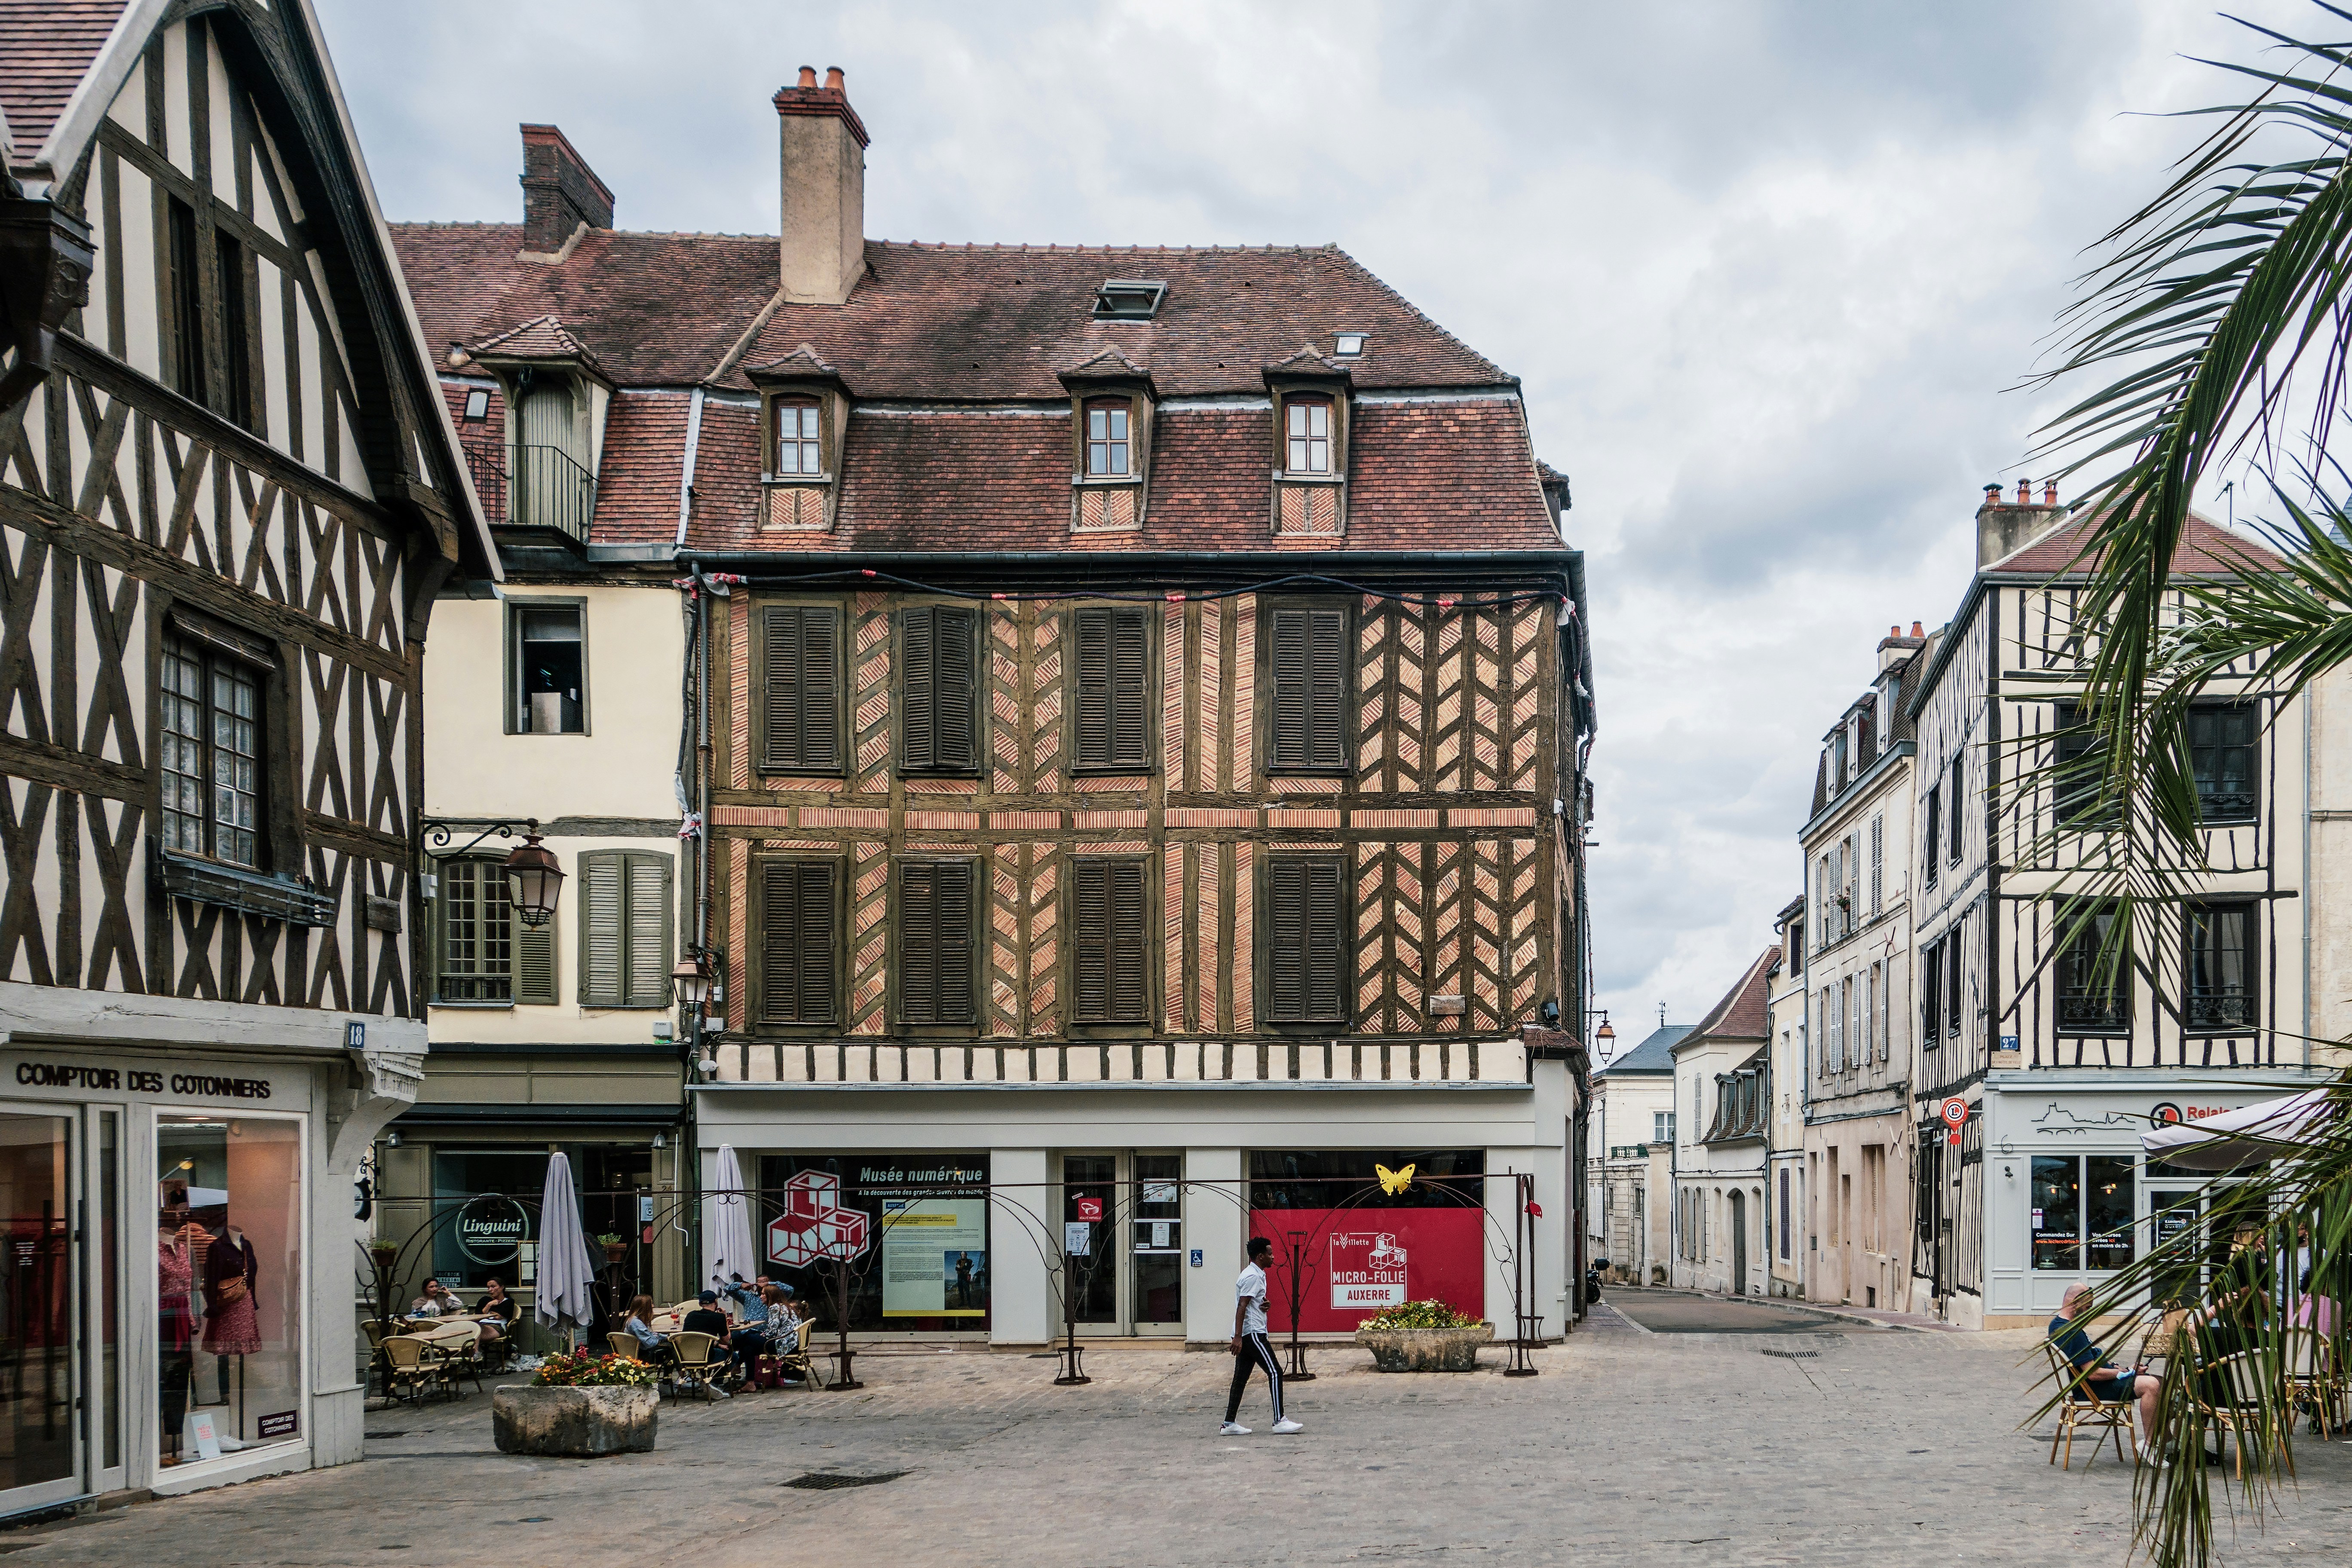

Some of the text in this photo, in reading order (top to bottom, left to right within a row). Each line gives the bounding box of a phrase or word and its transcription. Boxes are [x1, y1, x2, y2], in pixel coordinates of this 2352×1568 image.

[350, 1026, 362, 1045] 18
[2002, 1038, 2016, 1048] 27
[16, 1063, 270, 1099] COMPTOIR DES COTONNIERS
[2187, 1106, 2232, 1118] Relai
[860, 1166, 983, 1184] Musée numérique
[463, 1219, 522, 1235] Linguini
[1332, 1271, 1405, 1283] MICRO-FOLIE
[1347, 1289, 1390, 1301] AUXERRE
